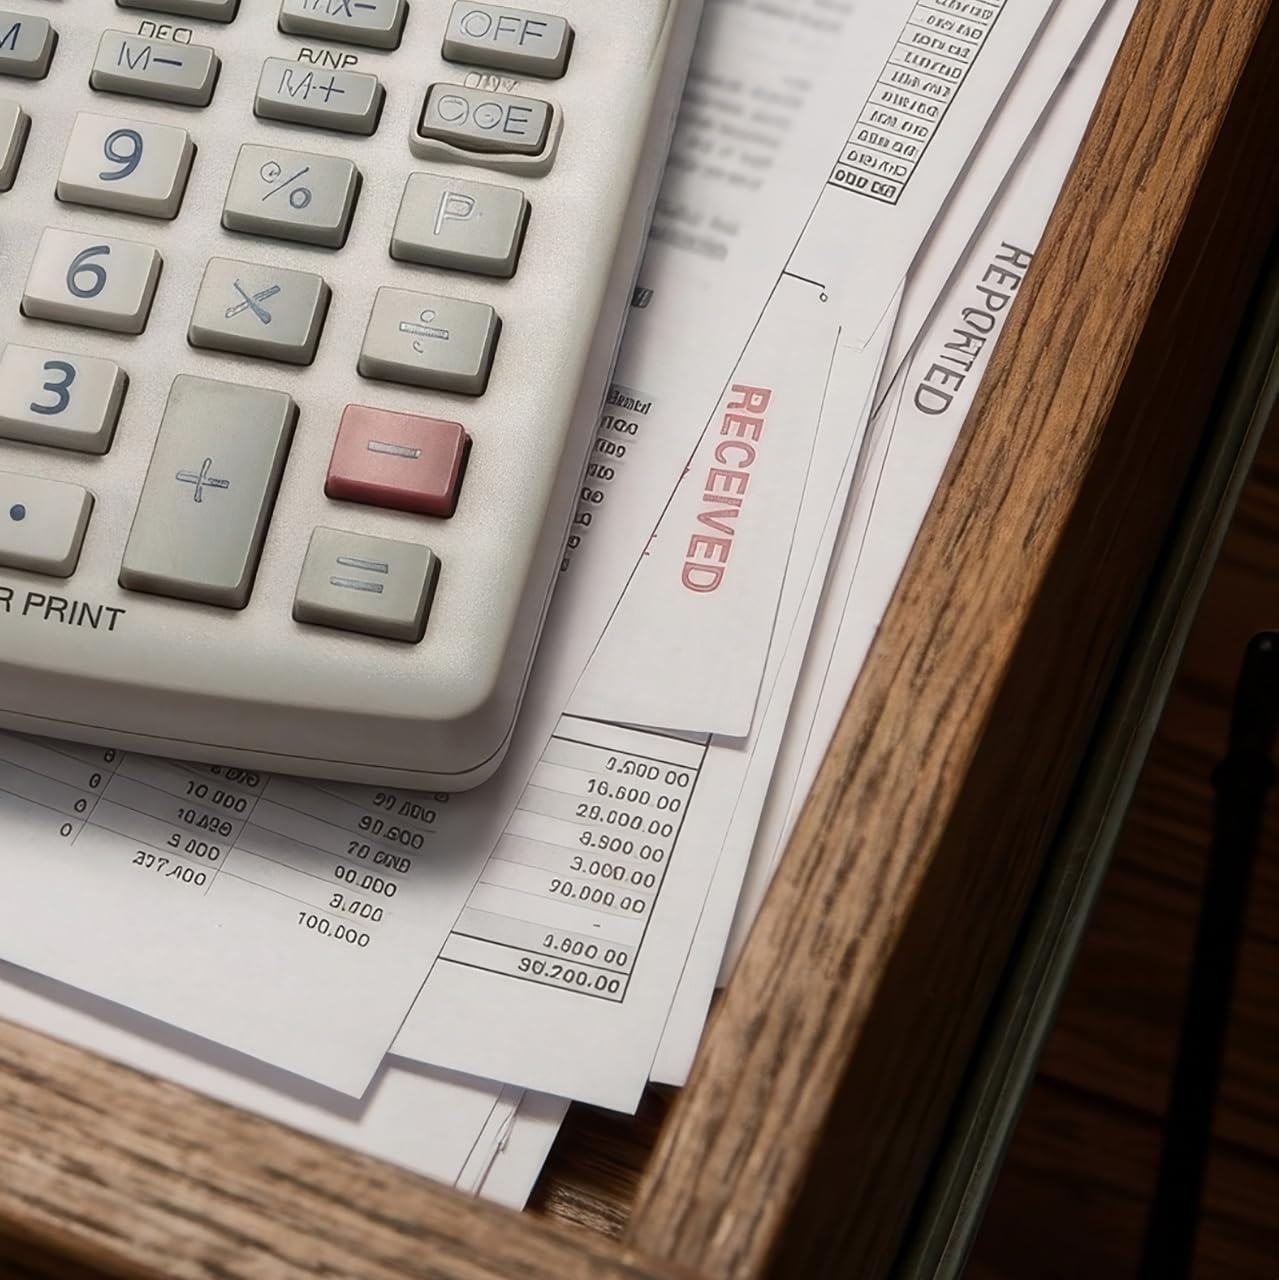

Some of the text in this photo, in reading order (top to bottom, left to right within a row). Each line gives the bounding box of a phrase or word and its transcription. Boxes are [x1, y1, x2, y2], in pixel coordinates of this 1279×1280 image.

[461, 10, 547, 45] OFF
[99, 128, 143, 180] 9
[433, 190, 476, 236] P
[66, 245, 111, 298] 6
[29, 360, 76, 415] 3
[681, 383, 773, 594] RECEIVED
[22, 591, 126, 631] PRINT
